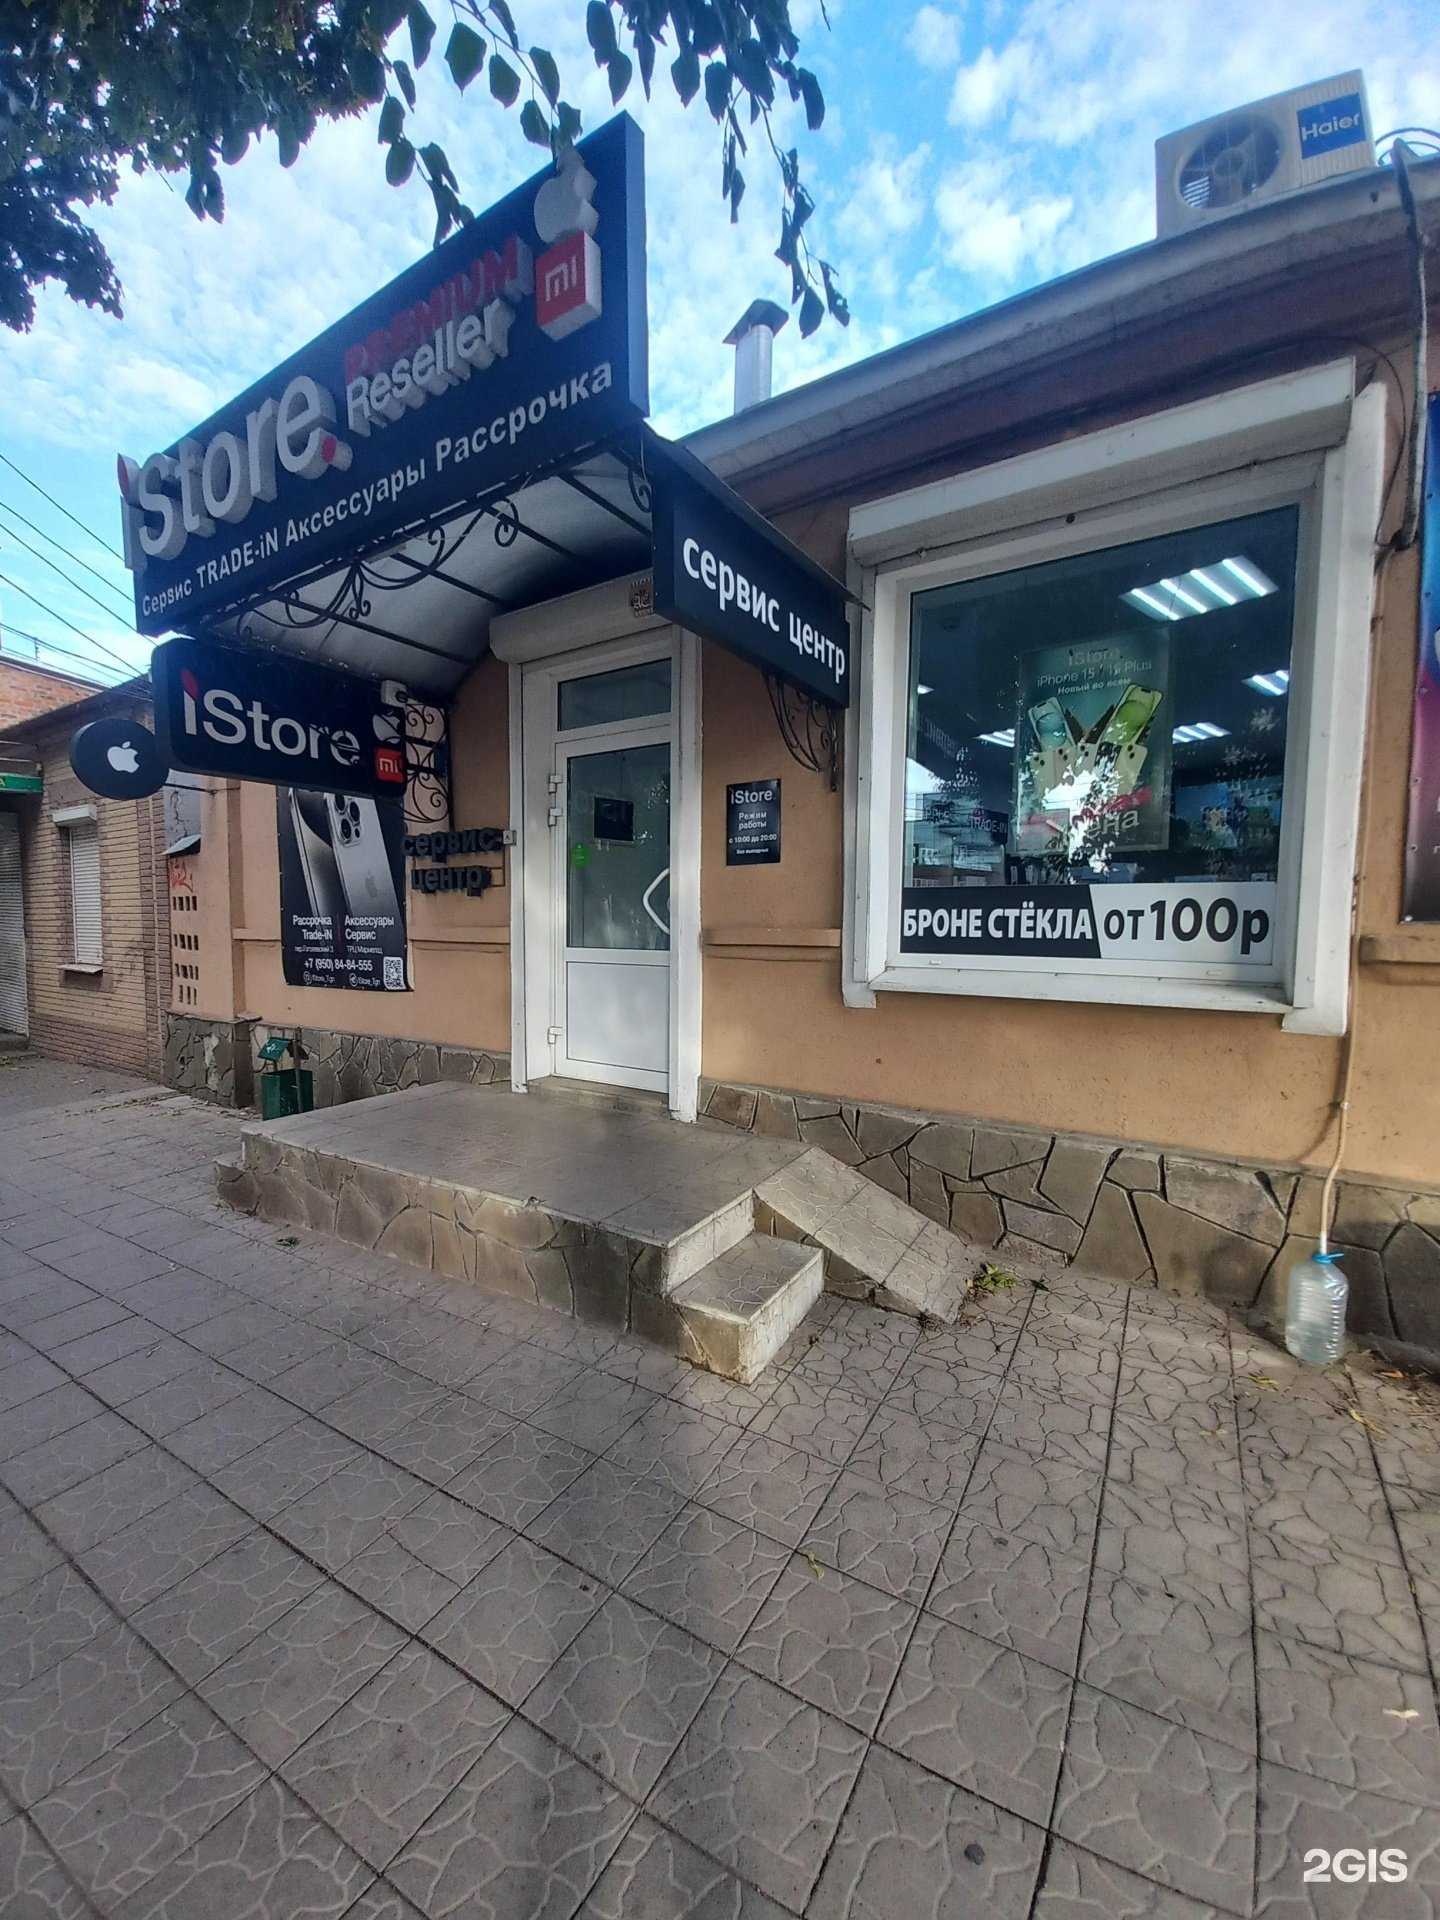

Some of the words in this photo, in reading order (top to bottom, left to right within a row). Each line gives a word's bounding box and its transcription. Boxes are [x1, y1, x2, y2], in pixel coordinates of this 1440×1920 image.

[1301, 112, 1360, 142] Haier
[346, 297, 512, 434] Reseller
[142, 580, 193, 617] Сервис
[196, 527, 279, 589] TRADE-iN
[286, 459, 426, 546] Аксессуары
[435, 362, 613, 471] Рассрочка
[683, 537, 780, 632] сервис
[789, 612, 846, 684] центр
[1037, 671, 1079, 688] iPhone
[1082, 666, 1097, 681] 15
[180, 668, 361, 766] iStore
[730, 789, 773, 805] iStore
[739, 812, 767, 820] Режим
[739, 821, 767, 831] работы
[411, 866, 487, 896] центр
[292, 914, 333, 926] Рассрочка
[344, 915, 394, 928] Аксессуары
[903, 908, 982, 938] БРОНЕ
[988, 901, 1094, 940] СТЁКЛА
[302, 928, 333, 940] Trade-iN
[344, 928, 377, 941] Сервис
[304, 958, 313, 969] +7
[315, 958, 334, 971] (950)
[334, 959, 374, 972] 84-84-555
